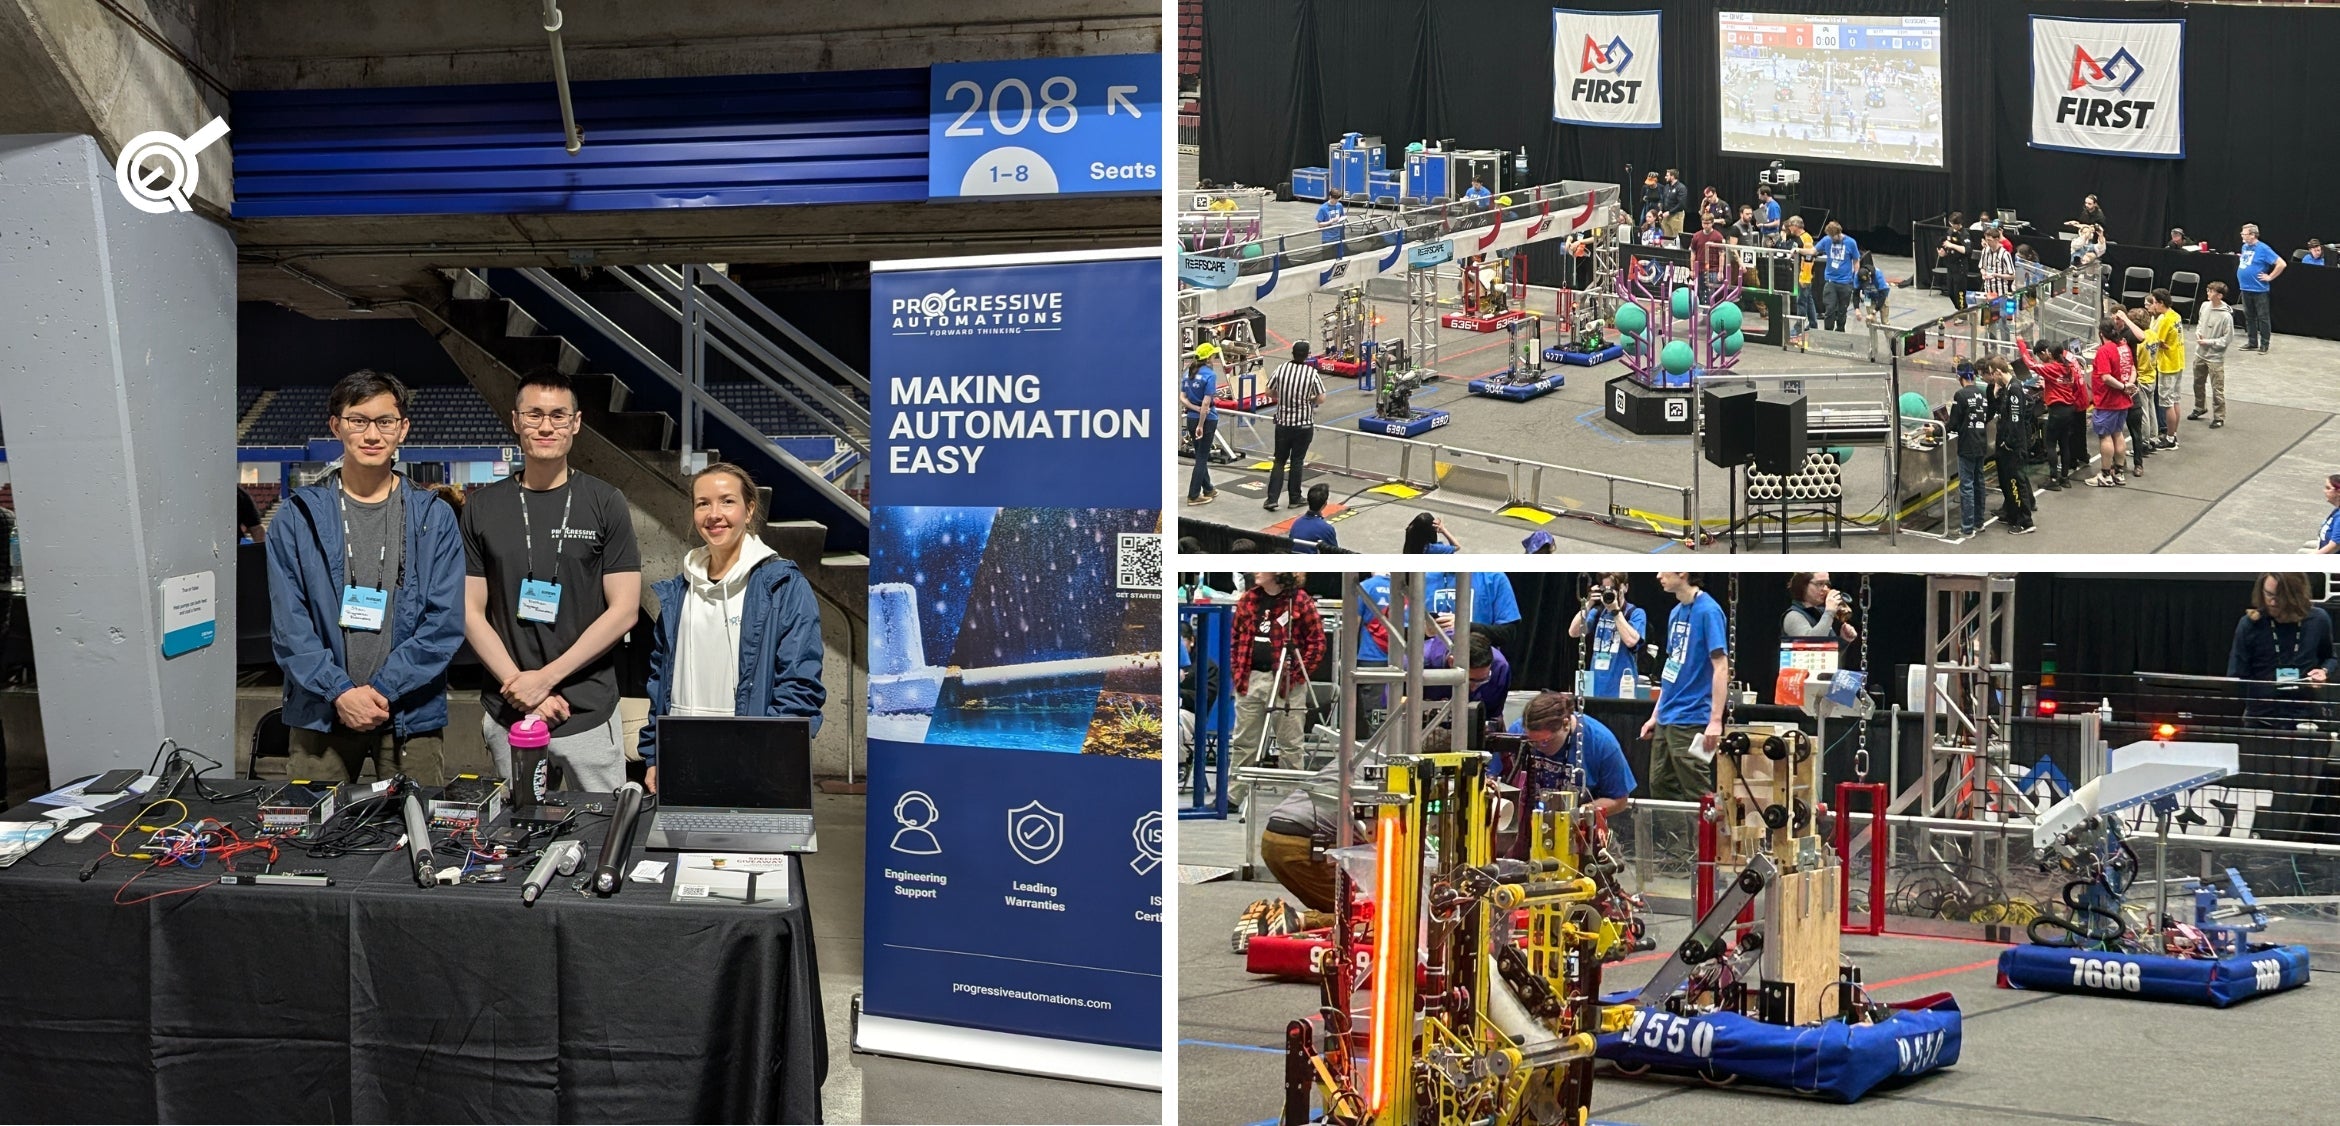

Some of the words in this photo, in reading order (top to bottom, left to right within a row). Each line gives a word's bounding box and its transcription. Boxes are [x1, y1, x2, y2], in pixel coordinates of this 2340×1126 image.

[1816, 36, 1836, 46] 0:00
[1571, 78, 1642, 104] FIRST
[944, 76, 1078, 137] 208
[2056, 96, 2155, 129] FIRST
[1090, 161, 1156, 180] Seats
[1417, 243, 1444, 256] REEFSCAPE
[1185, 258, 1226, 273] REEFSCAPE
[892, 289, 1063, 316] PROGRESSIVE
[892, 311, 1062, 328] AUTOMATIONS
[1450, 319, 1479, 330] 6364
[929, 328, 974, 336] FORWARD
[977, 327, 1021, 335] THINKING
[890, 374, 1041, 405] MAKING
[1484, 383, 1505, 394] 9044
[888, 408, 1150, 440] AUTOMATION
[1431, 414, 1449, 428] 6390
[1386, 424, 1407, 436] 6390
[889, 445, 985, 474] EASY
[551, 528, 597, 536] PRGRESSIVE
[884, 868, 947, 886] Engineering
[894, 885, 937, 899] Support
[1012, 880, 1058, 896] Leading
[1005, 896, 1066, 912] Warranties
[2069, 957, 2141, 993] 7688
[953, 982, 1112, 1010] progressiveautomations.com
